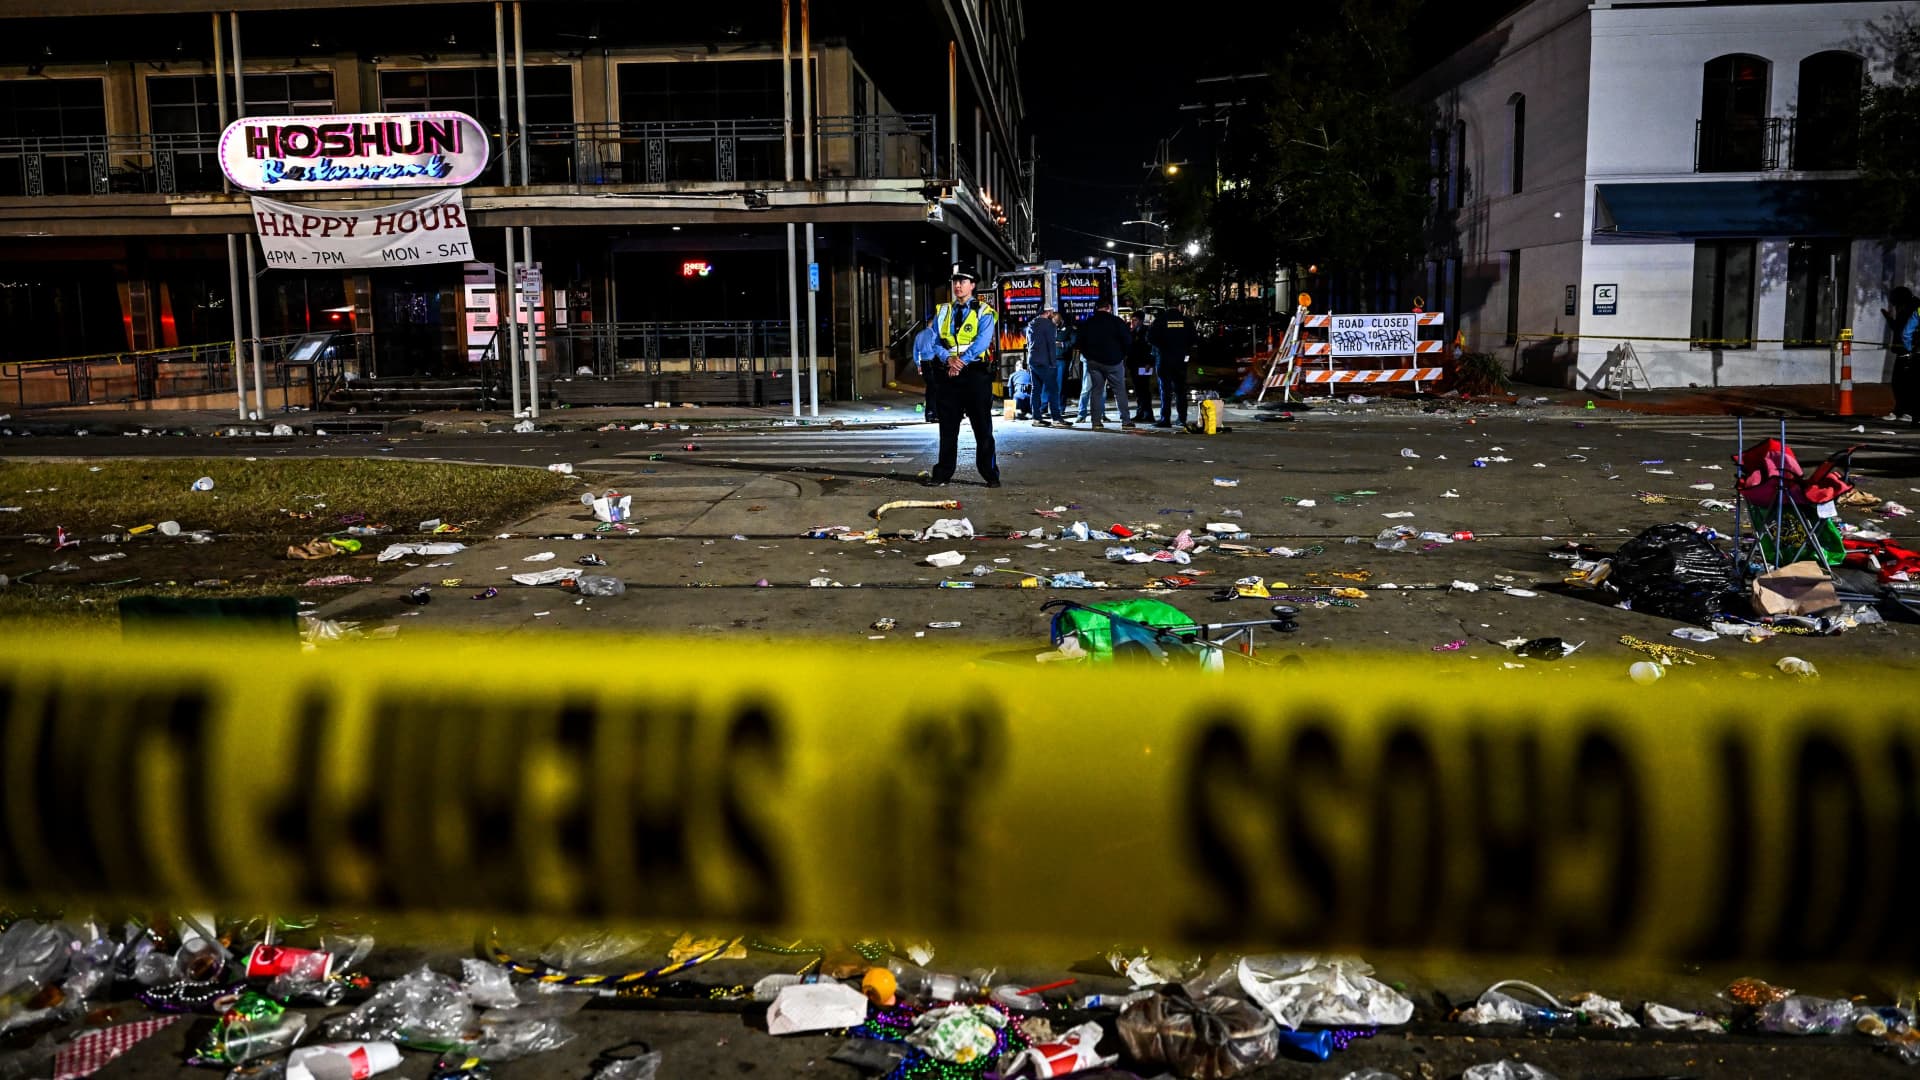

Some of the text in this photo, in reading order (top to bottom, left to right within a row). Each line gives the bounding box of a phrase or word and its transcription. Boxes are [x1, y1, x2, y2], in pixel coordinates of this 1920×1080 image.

[245, 119, 464, 159] HOSHUN
[260, 154, 453, 184] Restaurant
[257, 203, 466, 238] HAPPY HOUR
[266, 250, 297, 264] 4PM
[311, 251, 346, 264] 7PM
[382, 246, 420, 261] MON
[437, 242, 469, 257] SAT
[1011, 280, 1032, 288] NOLA
[1070, 279, 1090, 287] NOLA
[1338, 318, 1409, 328] ROAD CLOSED
[1368, 331, 1378, 339] TO
[1338, 341, 1409, 351] THRU TRAFFIC
